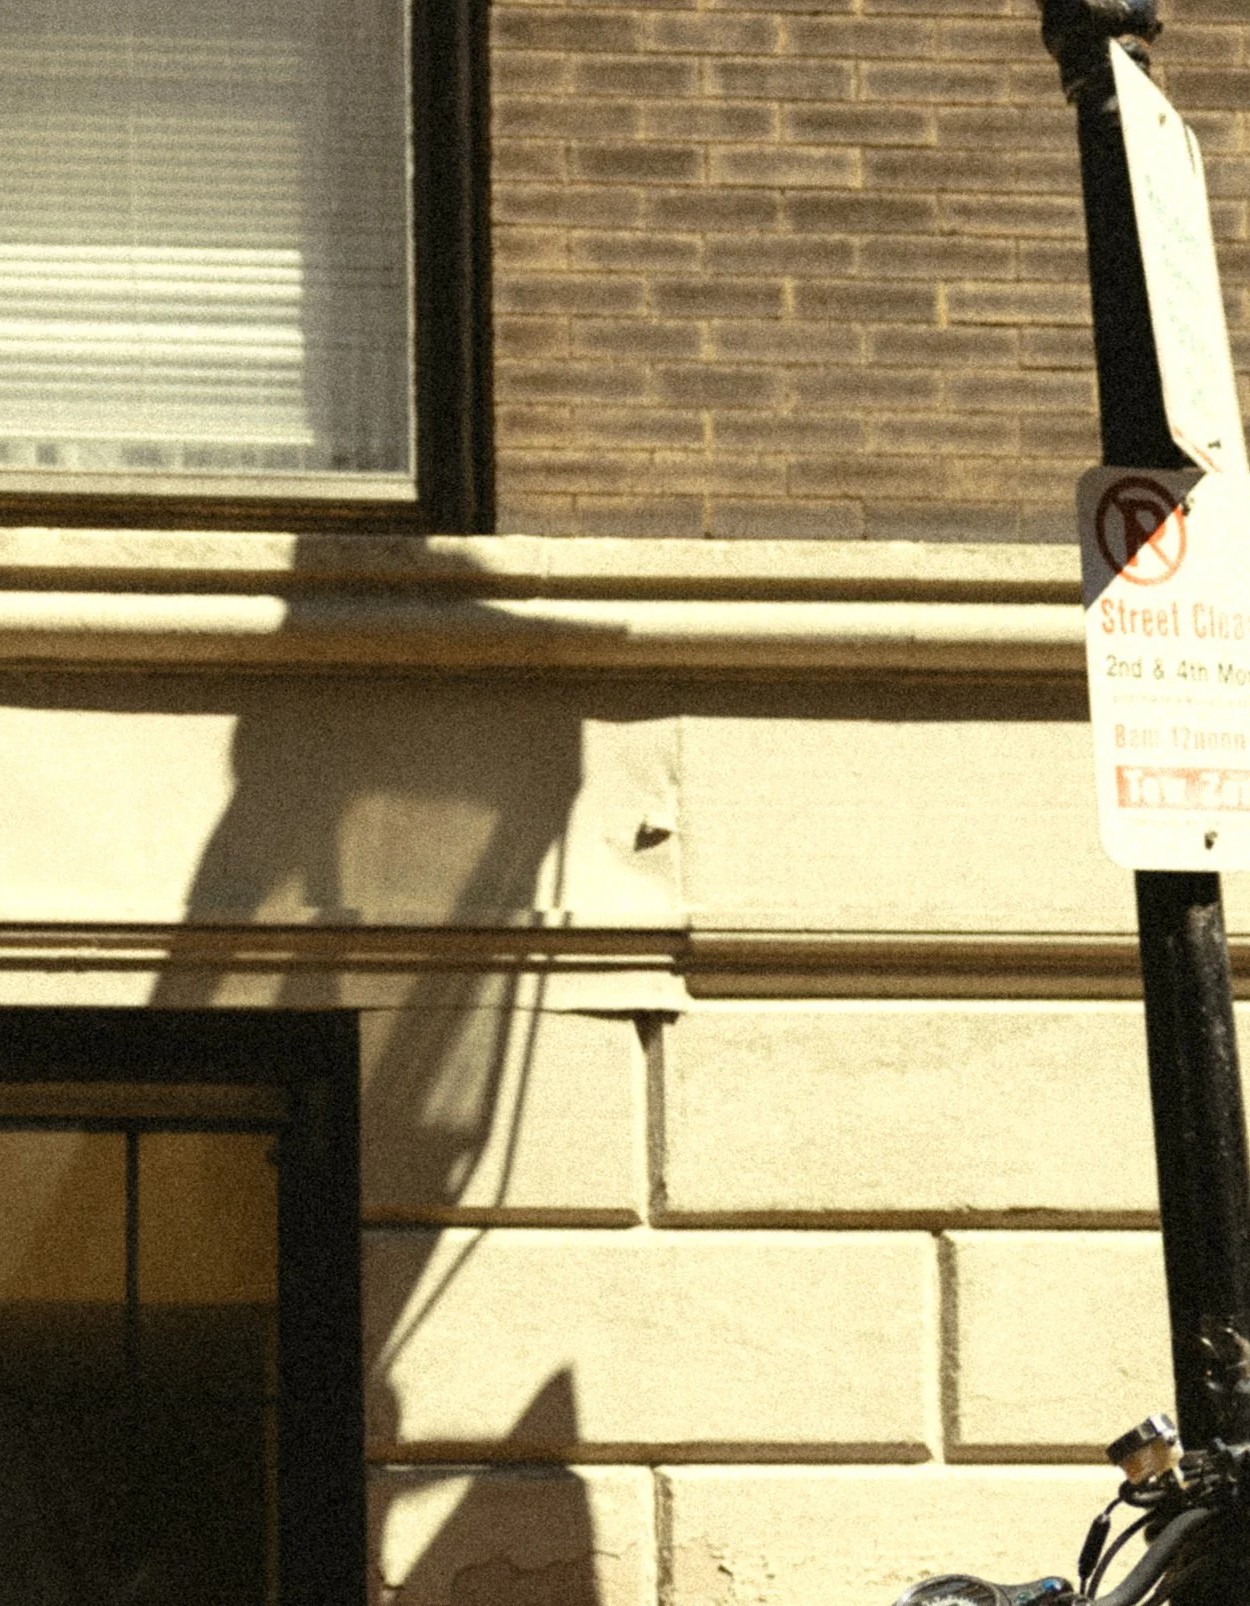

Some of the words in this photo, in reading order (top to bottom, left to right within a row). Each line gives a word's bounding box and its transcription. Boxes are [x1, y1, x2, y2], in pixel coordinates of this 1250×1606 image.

[1100, 597, 1180, 638] Street
[1192, 601, 1250, 641] Clea
[1105, 654, 1143, 680] 2nd
[1153, 657, 1165, 680] &
[1177, 659, 1209, 682] 4th
[1217, 661, 1250, 686] Mo
